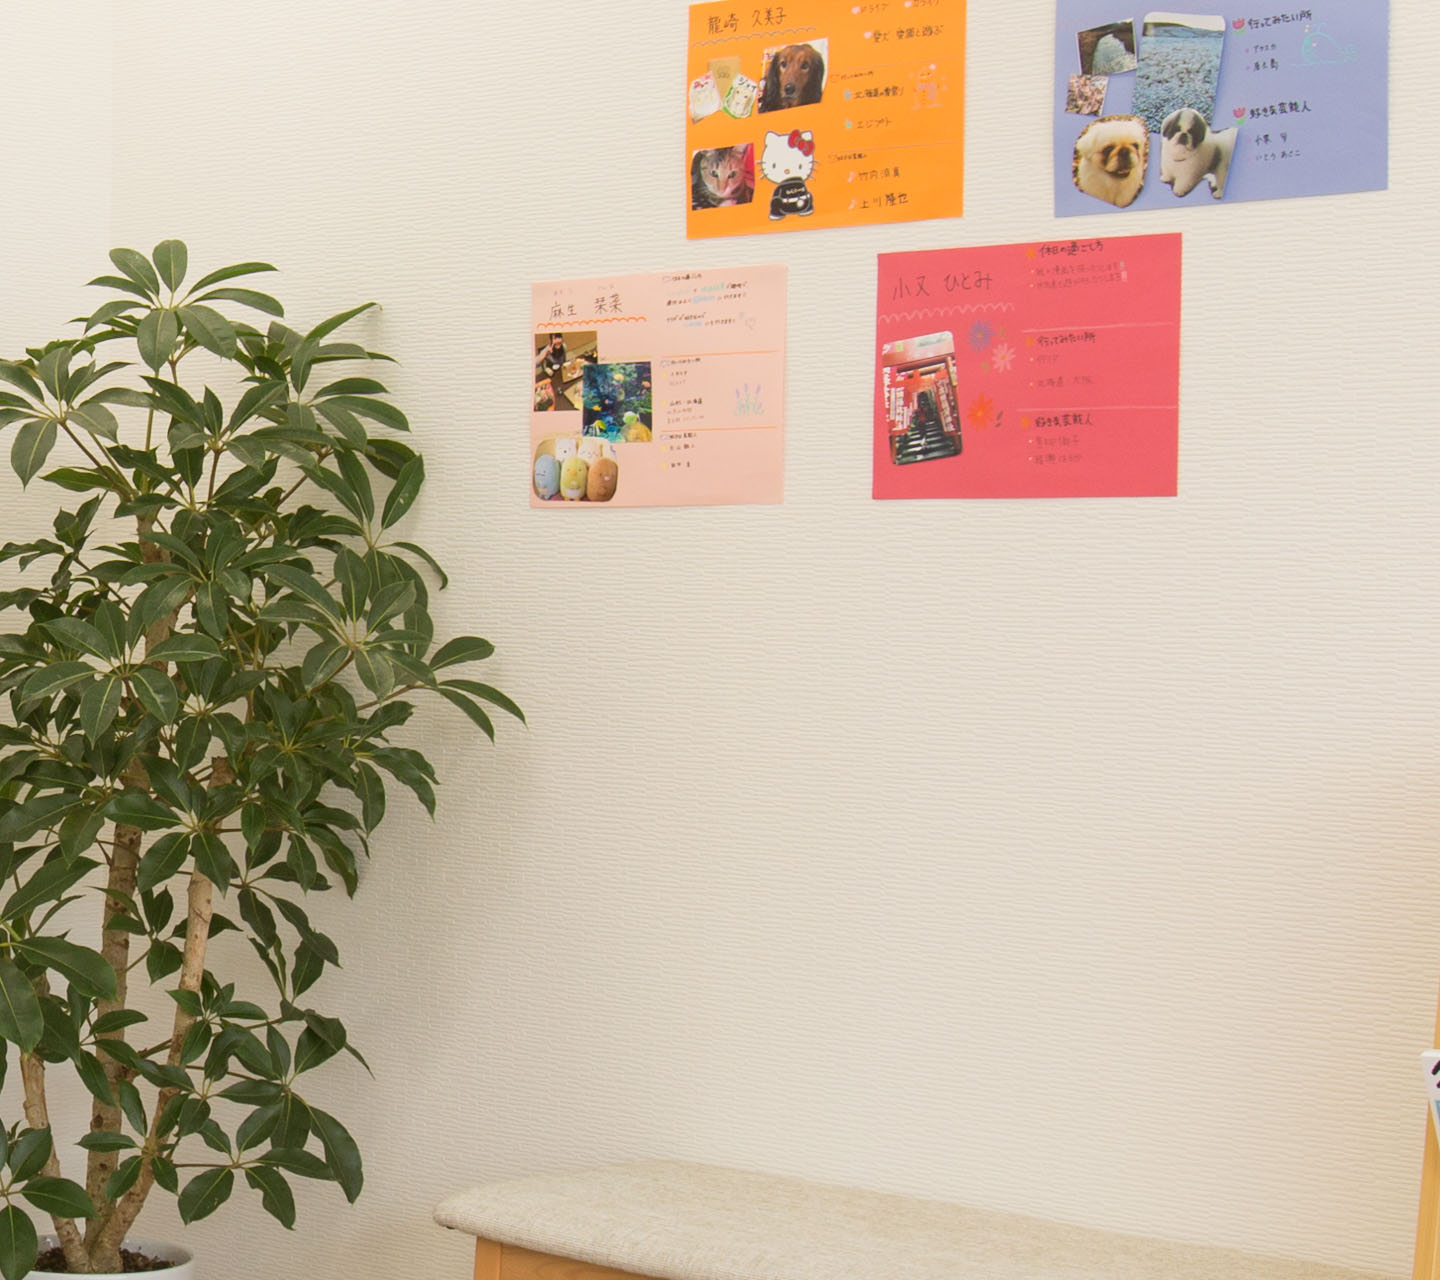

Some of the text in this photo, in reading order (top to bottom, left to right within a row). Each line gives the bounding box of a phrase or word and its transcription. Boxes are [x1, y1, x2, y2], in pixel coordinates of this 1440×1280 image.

[752, 6, 788, 27] 久美子
[1248, 9, 1313, 30] 行ってみたい所
[1249, 101, 1312, 120] 好きな芸能人
[856, 116, 893, 130] エジプト
[1039, 241, 1104, 258] 休日の過ごし方
[892, 270, 993, 301] 小又 ひとみ
[550, 301, 578, 321] 麻生
[1037, 331, 1097, 348] 行ってみたい所
[1035, 412, 1095, 428] 好きな芸能人
